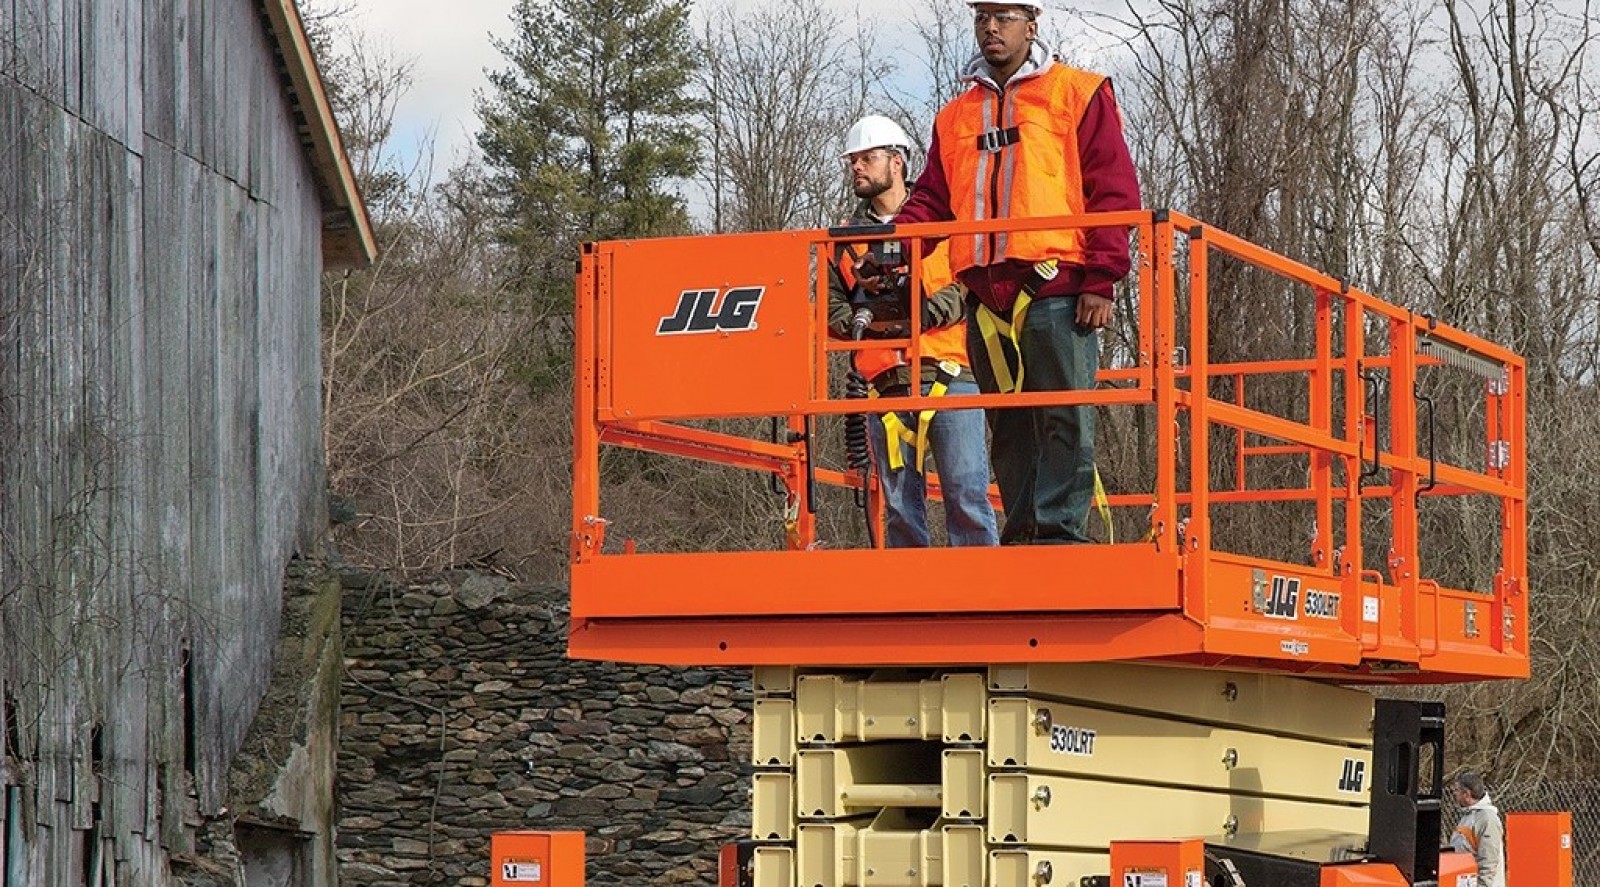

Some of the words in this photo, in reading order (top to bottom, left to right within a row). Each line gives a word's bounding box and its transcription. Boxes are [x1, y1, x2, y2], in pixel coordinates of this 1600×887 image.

[657, 287, 764, 334] JLG
[1265, 576, 1300, 618] JLG
[1304, 590, 1340, 618] 530LRT
[1050, 726, 1096, 755] 530LRT
[1338, 758, 1365, 793] JLG
